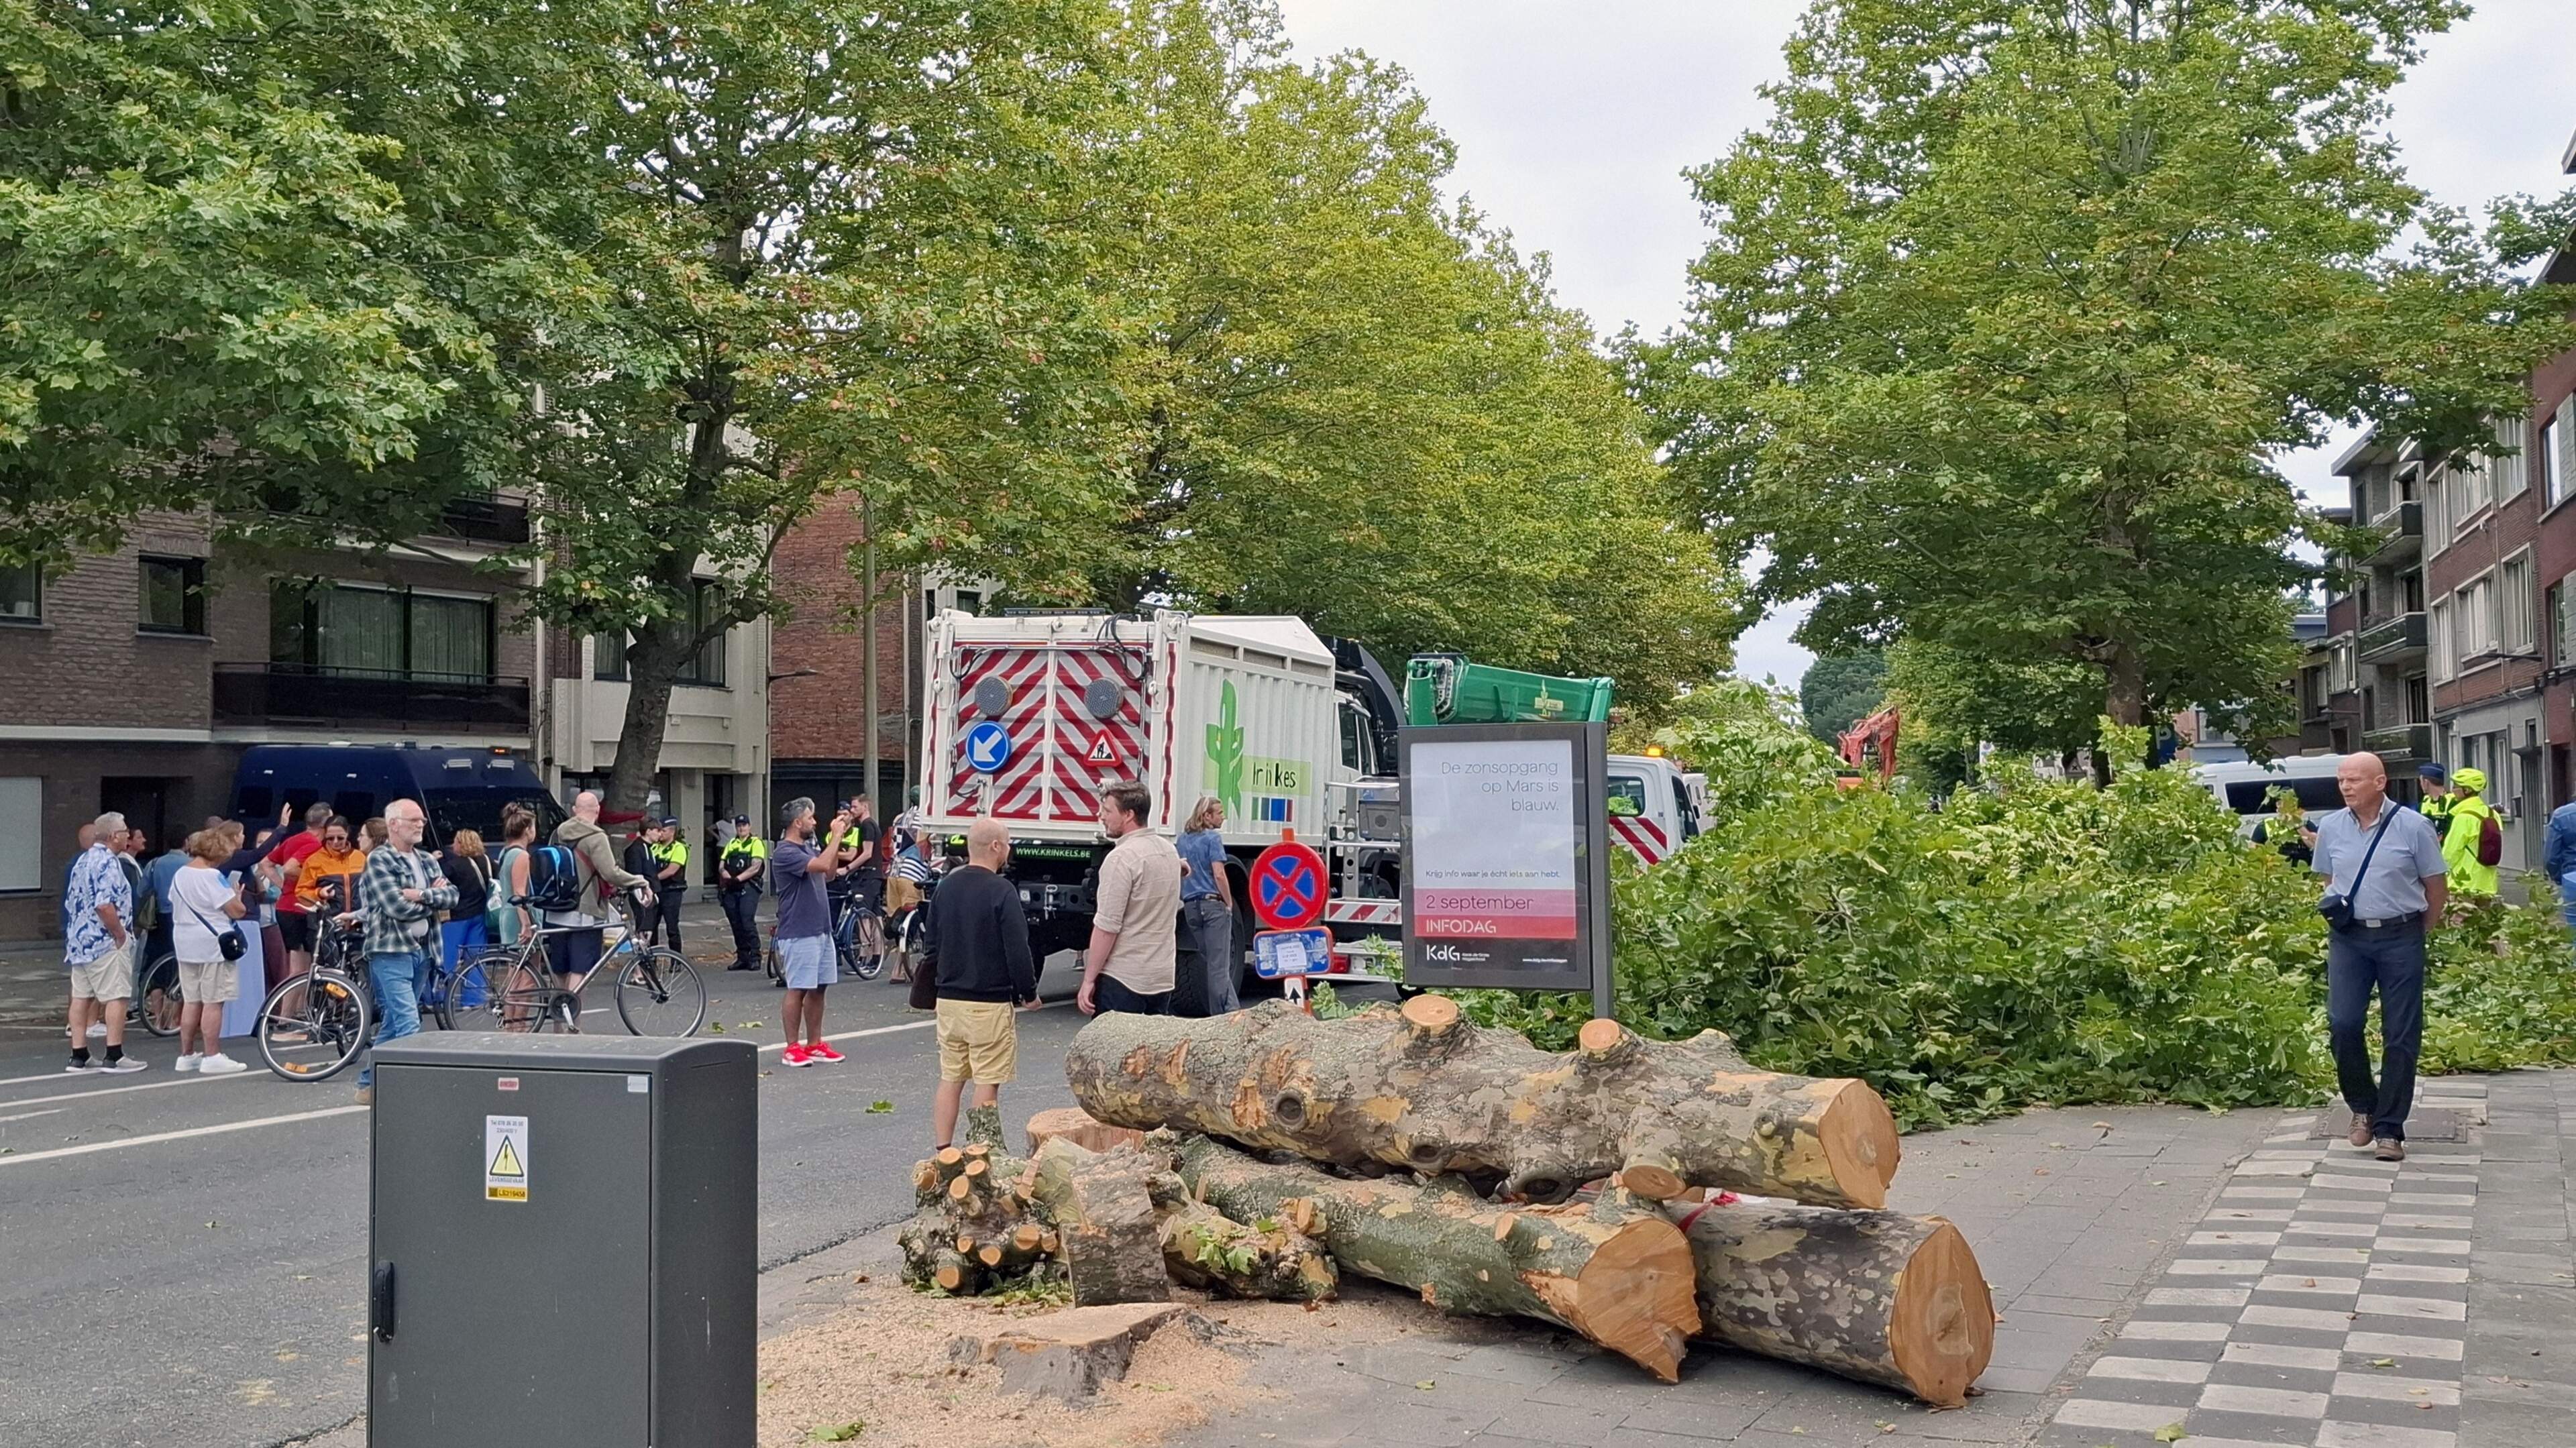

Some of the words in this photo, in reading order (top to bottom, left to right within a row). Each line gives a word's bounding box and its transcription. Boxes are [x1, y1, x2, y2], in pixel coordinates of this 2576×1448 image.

[2155, 726, 2171, 749] P
[1441, 762, 1460, 774] De
[1465, 762, 1558, 776] zonsopgang
[1481, 782, 1501, 794] op
[1507, 780, 1544, 792] Mars
[1548, 779, 1559, 792] is
[1511, 798, 1559, 812] blauw.
[1016, 847, 1091, 858] WWW.KRINKELS.BE
[1426, 869, 1442, 879] Krijg
[1444, 869, 1459, 878] info
[1426, 895, 1436, 909] 2
[1440, 895, 1534, 911] september
[1426, 919, 1497, 934] INFODAG
[1426, 944, 1460, 961] KdG
